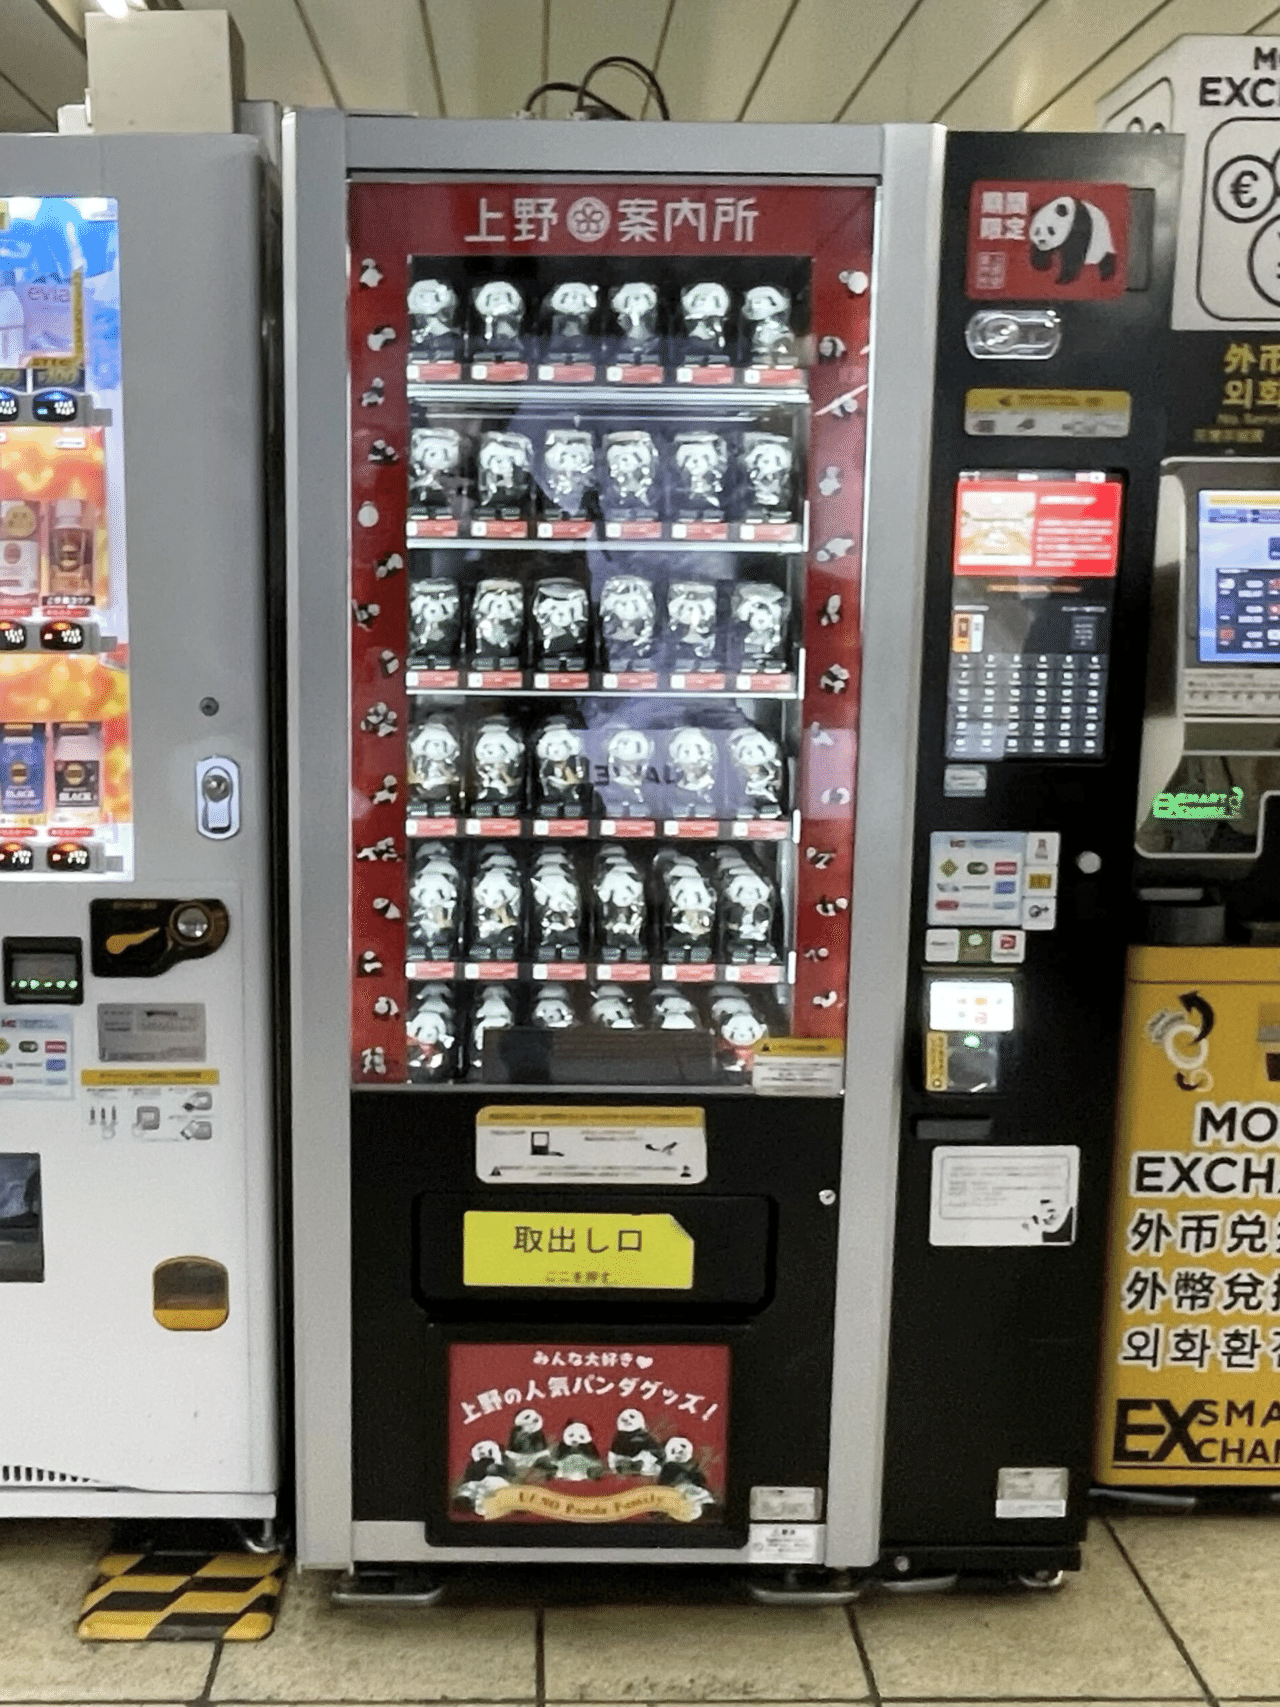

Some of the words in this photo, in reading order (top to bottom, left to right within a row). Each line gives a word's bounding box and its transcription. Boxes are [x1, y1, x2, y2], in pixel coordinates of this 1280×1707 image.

[1253, 46, 1280, 71] M
[1199, 76, 1280, 107] EXC
[464, 198, 558, 242] 上野
[617, 197, 759, 243] 案内所
[28, 287, 71, 303] evia
[1198, 1106, 1279, 1143] MO
[1135, 1156, 1280, 1194] EXCH
[513, 1225, 643, 1254] 取出し口
[1131, 1212, 1280, 1253] 外币兑
[1126, 1271, 1280, 1311] 外幣兌
[532, 1349, 634, 1368] みんな大好き
[1122, 1327, 1280, 1369] 외화환
[1113, 1399, 1204, 1463] EX
[1198, 1437, 1280, 1464] CHA
